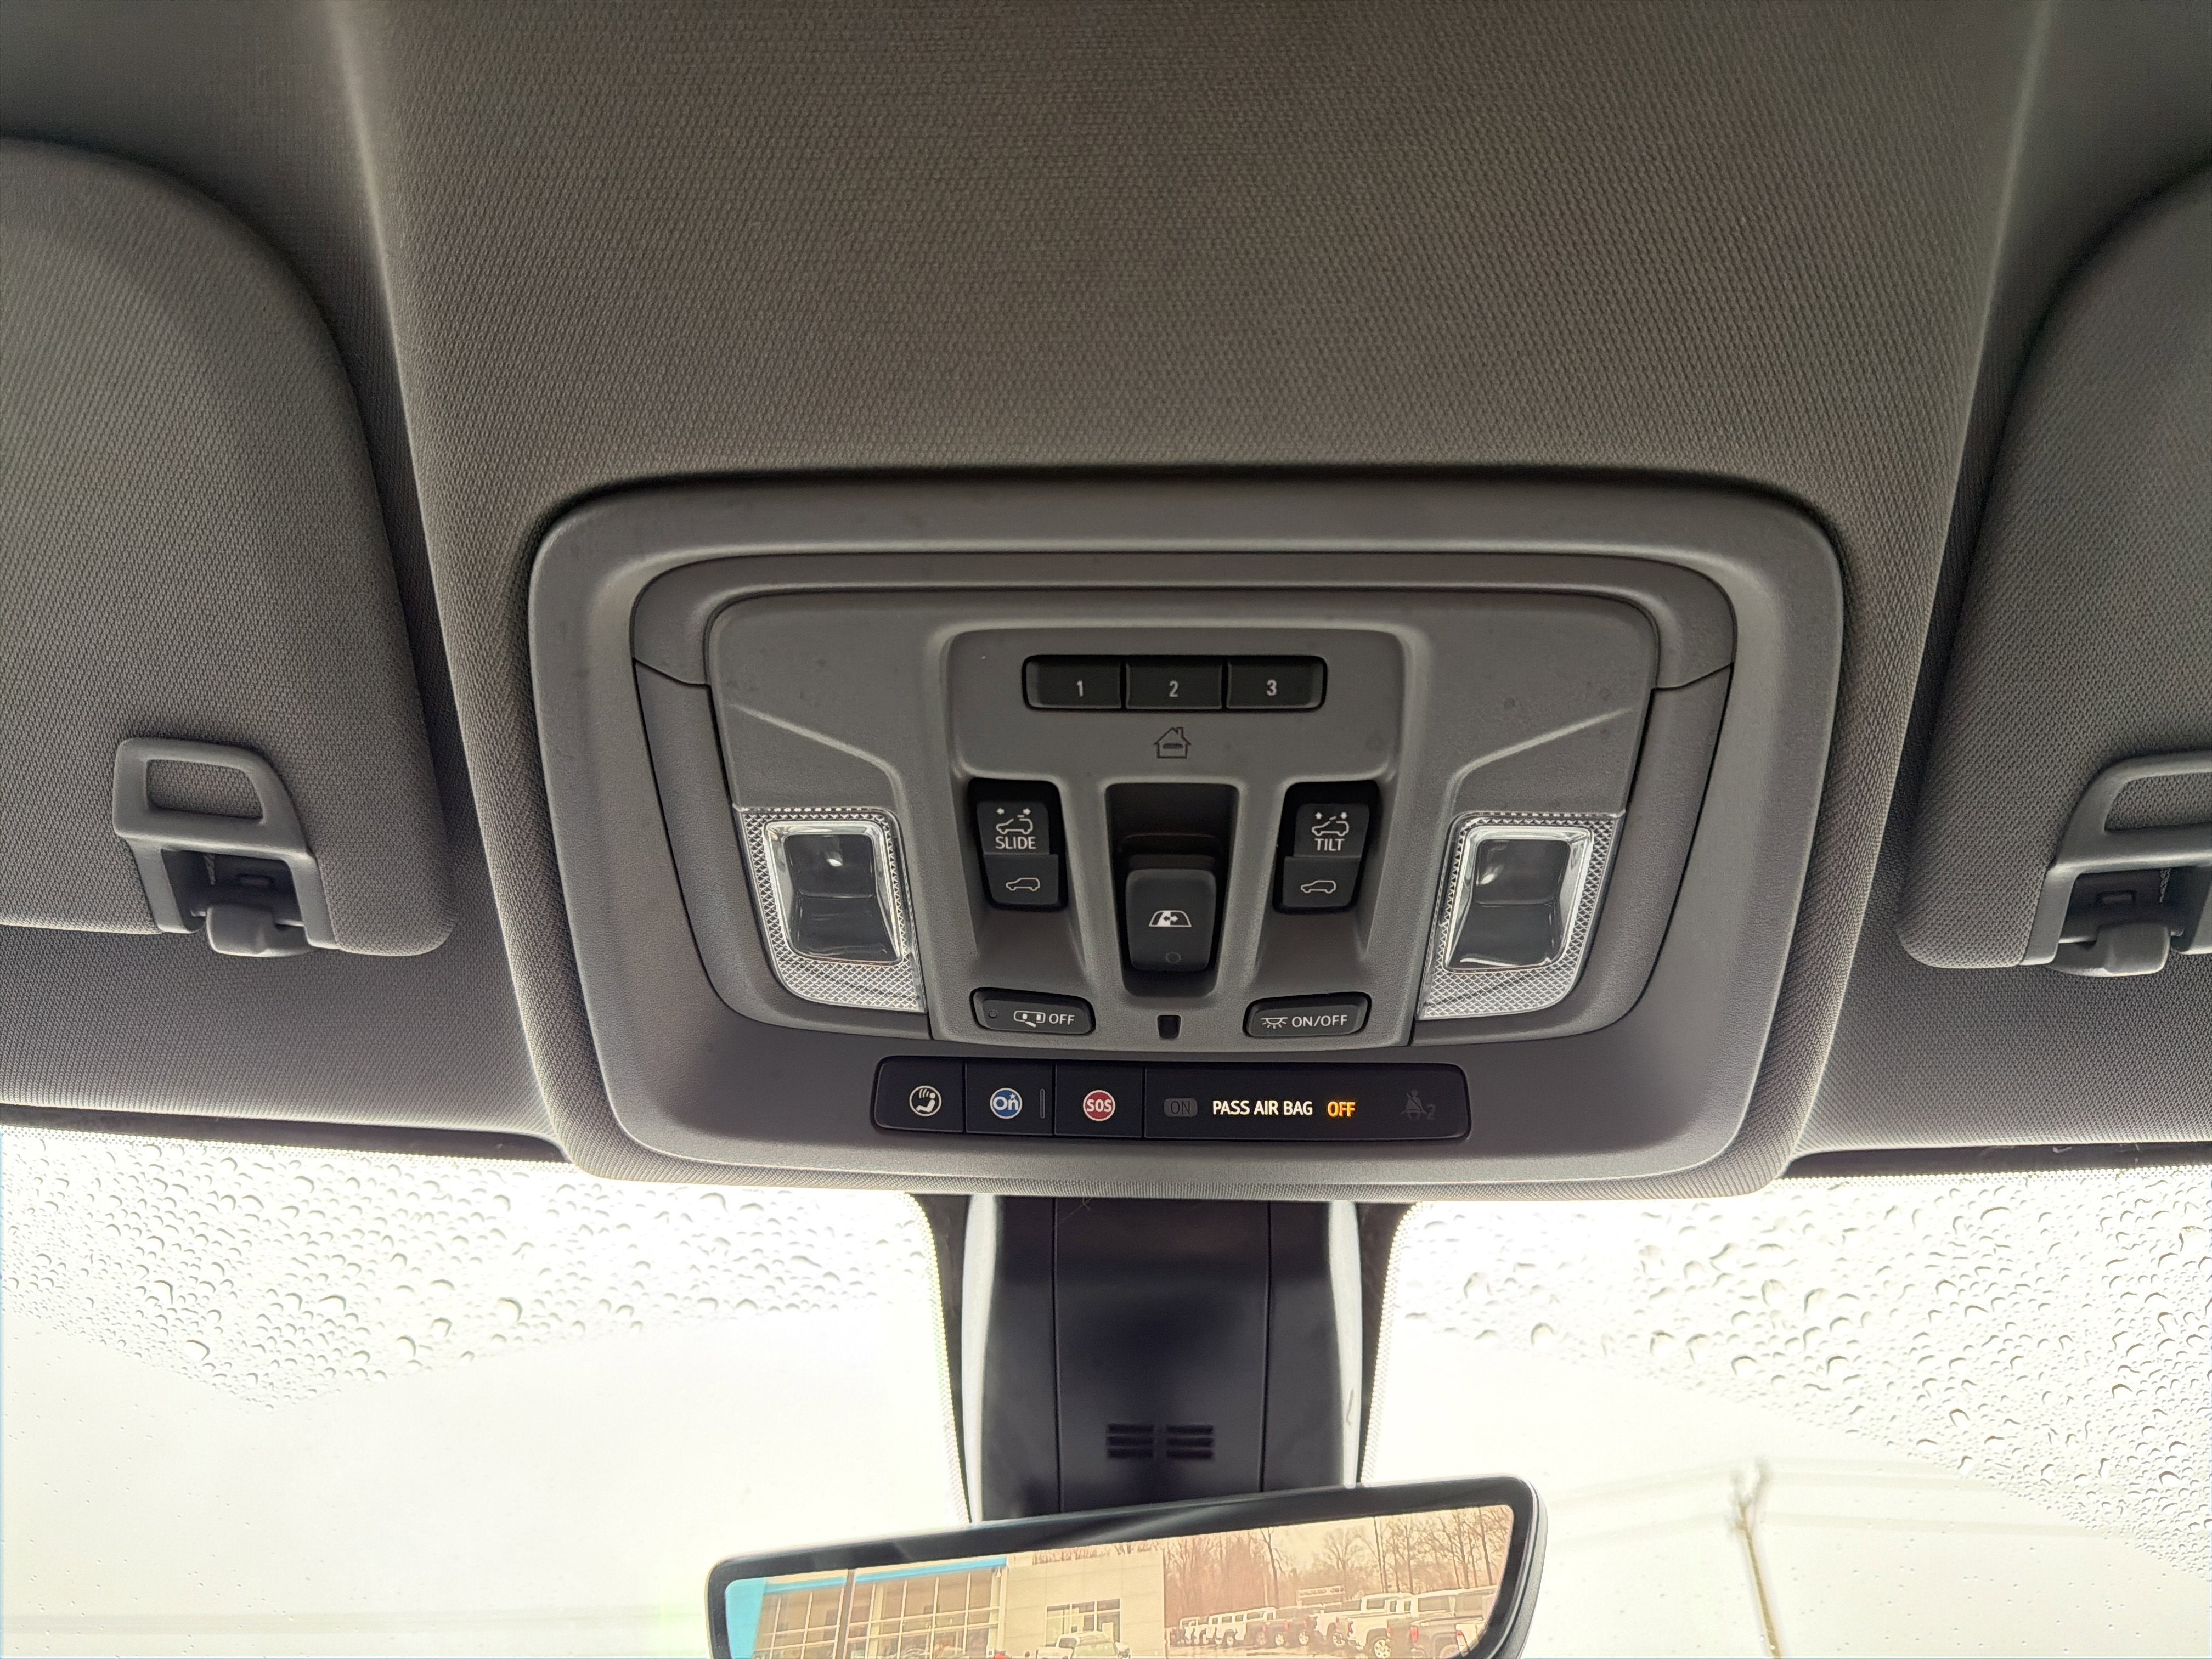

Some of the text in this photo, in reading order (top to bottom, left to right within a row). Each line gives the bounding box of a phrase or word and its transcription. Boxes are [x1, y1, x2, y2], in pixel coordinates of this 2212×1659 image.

[1077, 679, 1277, 697] 1 2 3
[995, 836, 1036, 849] SLIDE
[1314, 838, 1345, 851] TILT
[1048, 1013, 1075, 1025] OFF
[1291, 1014, 1348, 1028] ON/OFF
[993, 1096, 1019, 1110] On
[1086, 1099, 1112, 1113] SOS
[1170, 1100, 1356, 1117] ON PASS AIR BAG OFF
